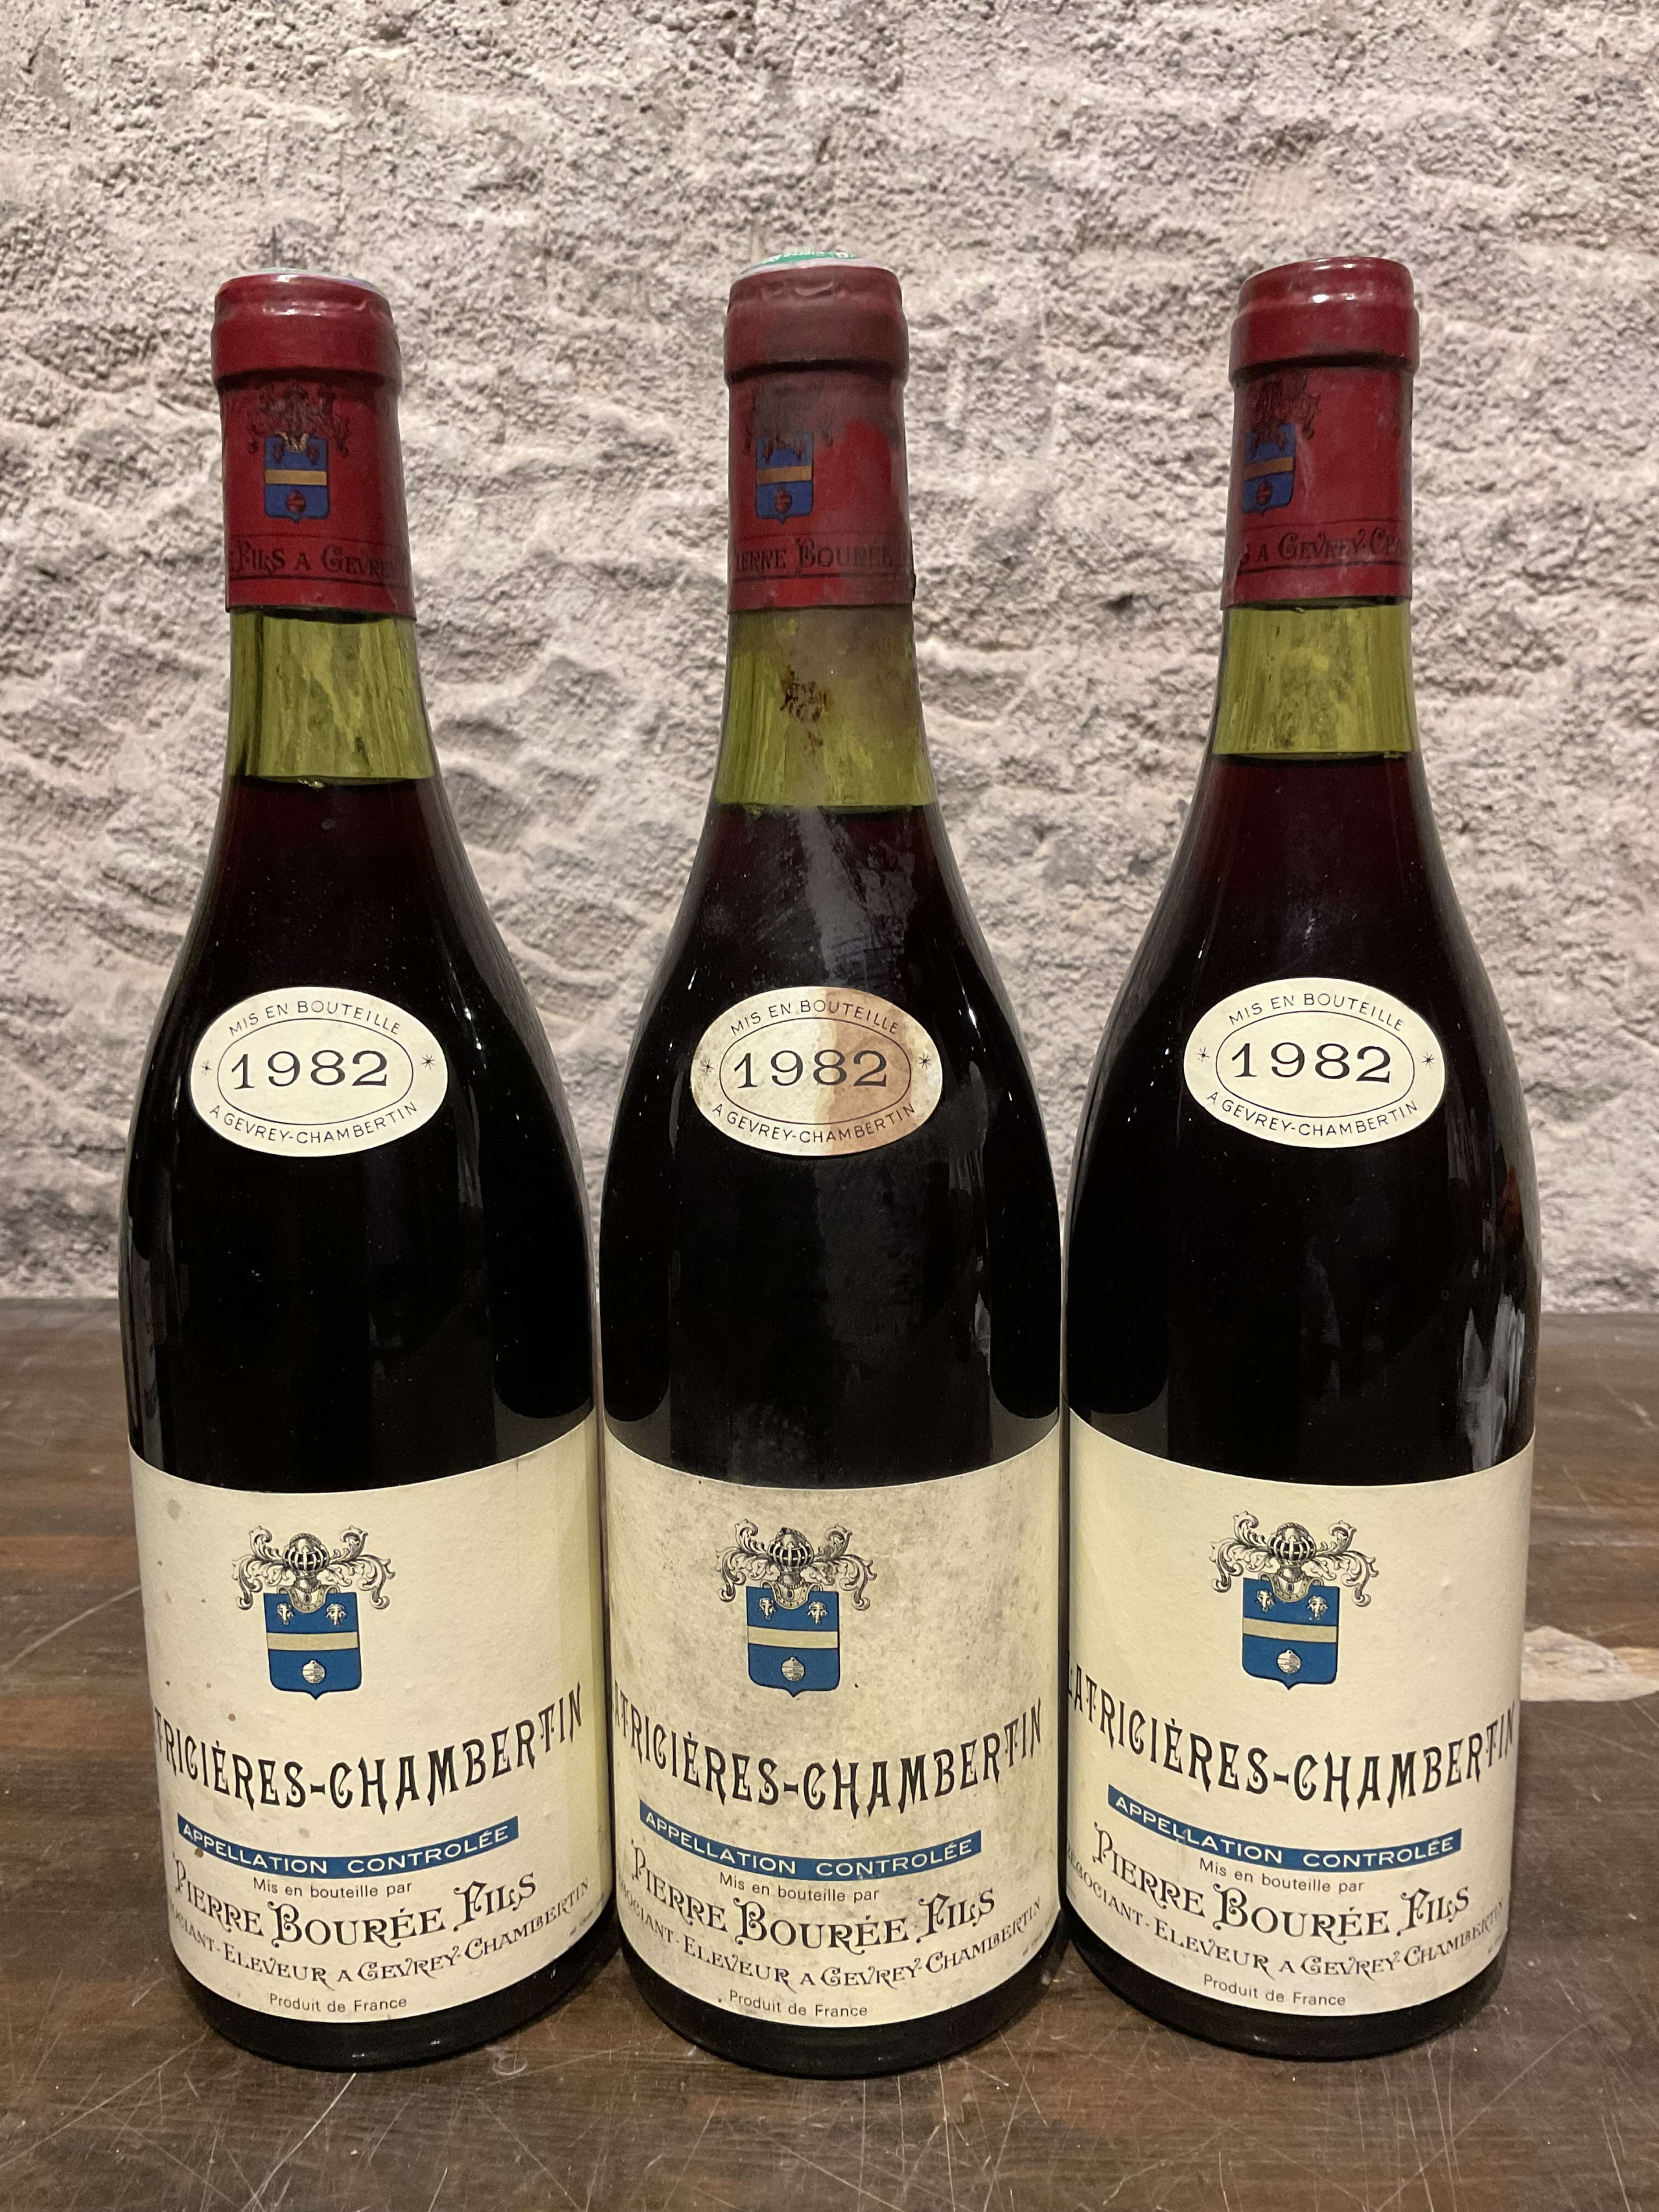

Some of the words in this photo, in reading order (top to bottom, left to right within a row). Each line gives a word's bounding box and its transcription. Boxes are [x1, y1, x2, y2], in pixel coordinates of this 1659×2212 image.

[296, 552, 311, 570] A
[735, 549, 787, 572] IERRE
[1257, 544, 1269, 562] A
[229, 1013, 259, 1036] MIS
[266, 1003, 288, 1019] EN
[297, 1000, 400, 1035] BOUTEILLE
[731, 1012, 761, 1036] MIS
[769, 1003, 791, 1018] EN
[801, 999, 898, 1034] BOUTEILLE
[1229, 1003, 1262, 1025] MIS
[1271, 995, 1294, 1009] EN
[1304, 993, 1404, 1031] BOUTEILLE
[231, 1050, 388, 1089] 1982
[734, 1049, 887, 1089] 1982
[1231, 1042, 1391, 1084] 1982
[210, 1104, 219, 1119] A
[224, 1101, 418, 1144] GEVREY-CHAMBERTIN
[712, 1104, 722, 1118] A
[726, 1102, 915, 1143] GEVREY-CHAMBERTIN
[1207, 1091, 1218, 1106] A
[1222, 1100, 1417, 1137] GEVREY-CHAMBERTIN
[183, 1824, 327, 1874] APPELLATION
[347, 1825, 509, 1873] CONTROLÉE
[646, 1812, 796, 1874] APPELLATION
[816, 1839, 972, 1876] CONTROLÉE
[1115, 1797, 1282, 1865] APPELLATION
[1303, 1837, 1453, 1868] CONTROLÉE
[253, 1878, 278, 1893] Mis
[285, 1887, 303, 1897] en
[310, 1885, 378, 1899] bouteille
[387, 1882, 412, 1898] par
[720, 1872, 745, 1890] Mis
[752, 1883, 770, 1896] en
[778, 1885, 845, 1902] bouteille
[853, 1889, 879, 1903] par
[1092, 1822, 1205, 1918] PIERRE
[1212, 1883, 1391, 1946] BOURÉE
[1397, 1886, 1469, 1937] FILS
[1200, 1857, 1227, 1877] Mis
[1235, 1871, 1253, 1883] en
[1262, 1873, 1330, 1892] bouteille
[1338, 1881, 1364, 1894] par
[172, 1852, 264, 1937] PIERRE
[267, 1901, 446, 1948] BOURÉE
[454, 1872, 537, 1931] FILS
[631, 1839, 728, 1933] PIERRE
[733, 1897, 909, 1955] BOURÉE
[916, 1889, 995, 1943] FILS
[337, 1970, 353, 1982] A
[357, 1876, 588, 1981] GEVREY-CHAMBERTIN
[799, 1972, 816, 1986] A
[820, 1896, 1040, 1990] GEVREY-CHAMBERTIN
[1279, 1961, 1295, 1973] A
[270, 1993, 320, 2012] Produit
[327, 2000, 345, 2012] de
[354, 1997, 407, 2012] France
[730, 1990, 781, 2013] Produit
[788, 2003, 806, 2016] de
[815, 2005, 867, 2017] France
[1204, 1974, 1259, 1998] Produit
[1265, 1990, 1284, 2003] de
[1293, 1992, 1346, 2006] France
